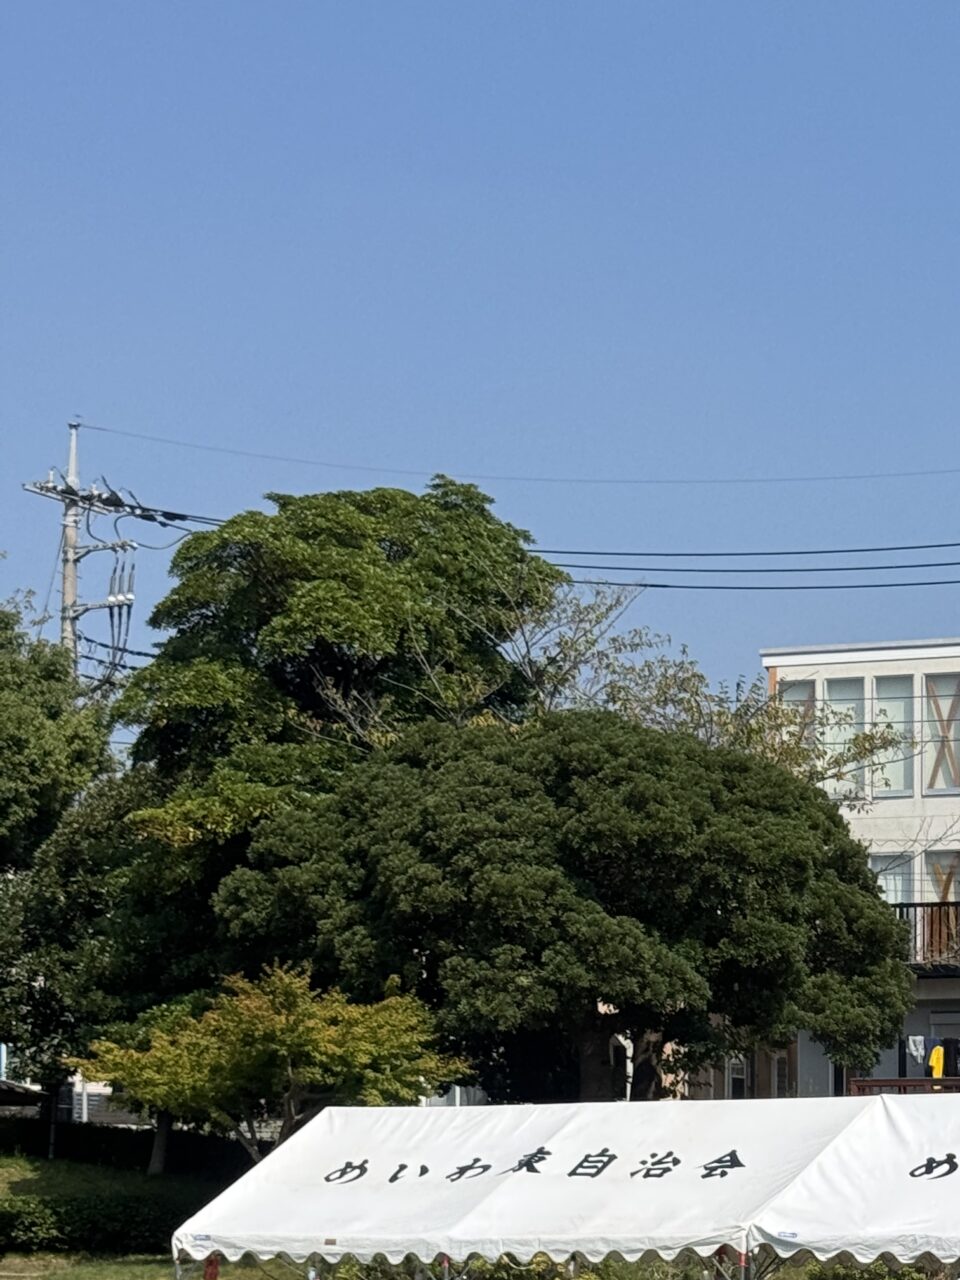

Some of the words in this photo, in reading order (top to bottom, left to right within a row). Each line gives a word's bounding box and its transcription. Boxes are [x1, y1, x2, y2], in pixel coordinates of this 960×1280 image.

[324, 1146, 745, 1184] めいわ東自治会
